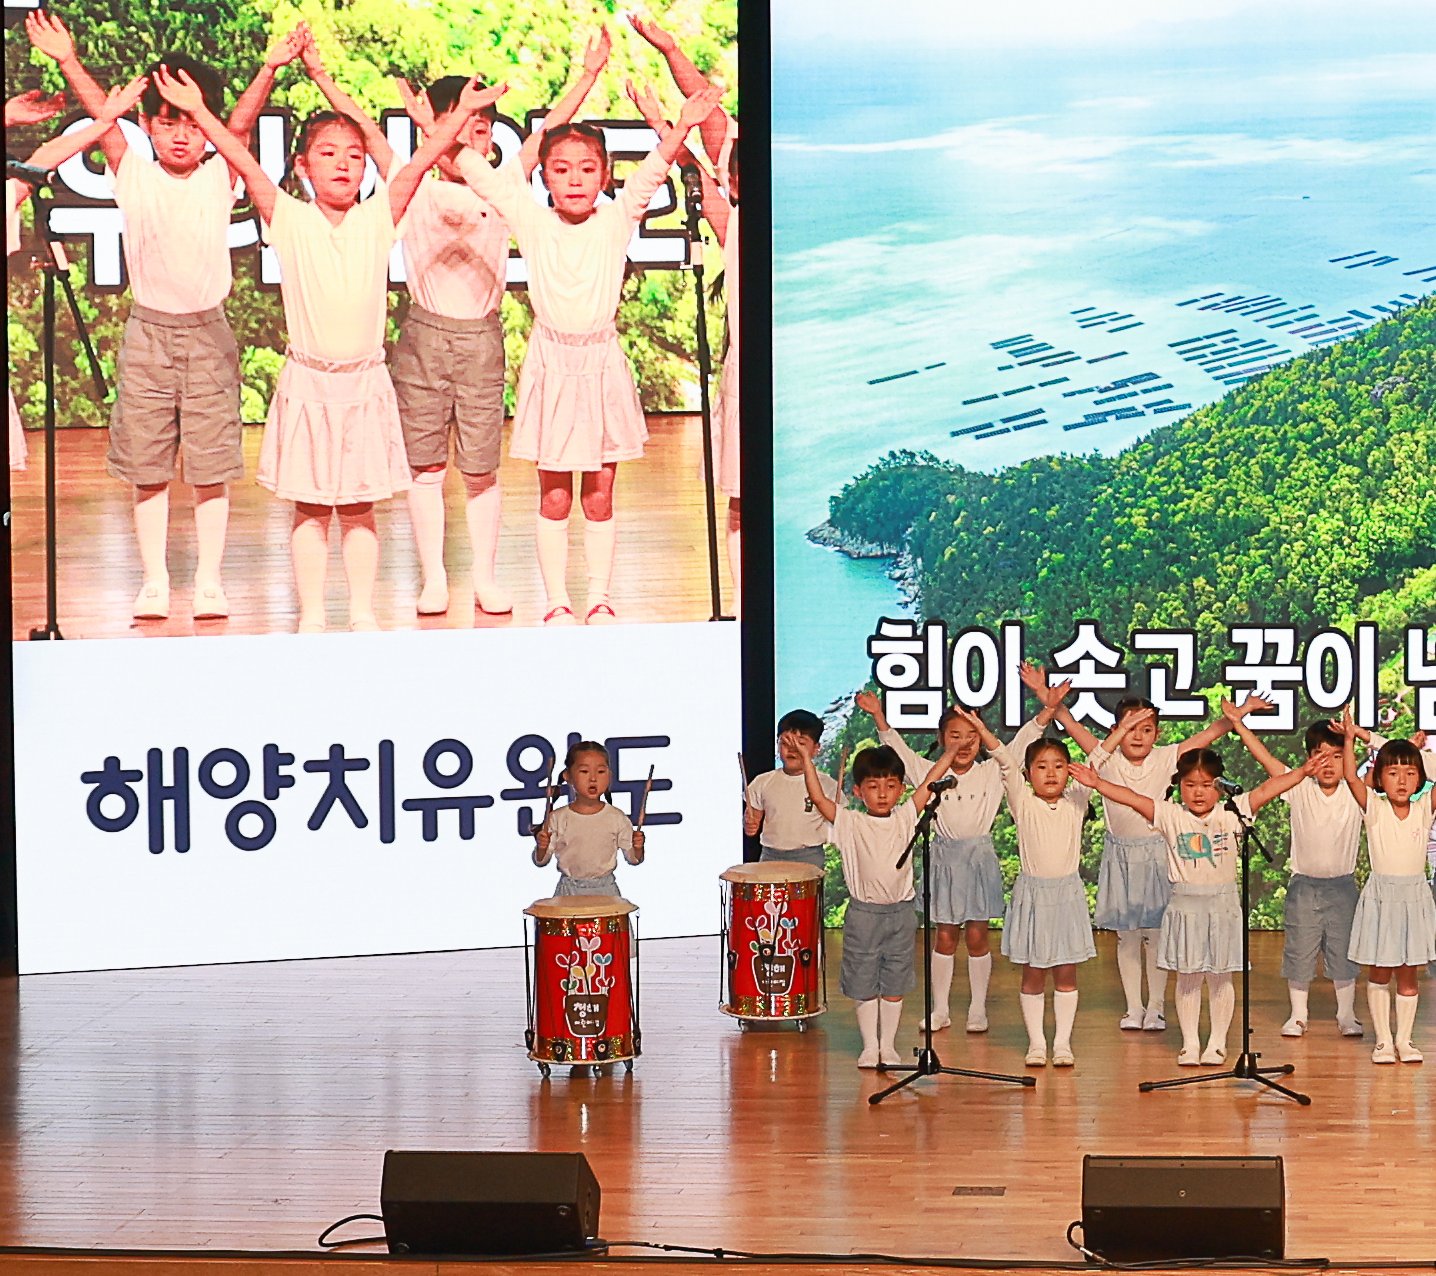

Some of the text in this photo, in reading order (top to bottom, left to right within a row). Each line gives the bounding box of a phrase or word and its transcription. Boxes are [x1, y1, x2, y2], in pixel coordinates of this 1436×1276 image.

[868, 619, 1023, 729] 힘이
[1053, 622, 1207, 729] 솟고
[1225, 625, 1376, 729] 꿈이
